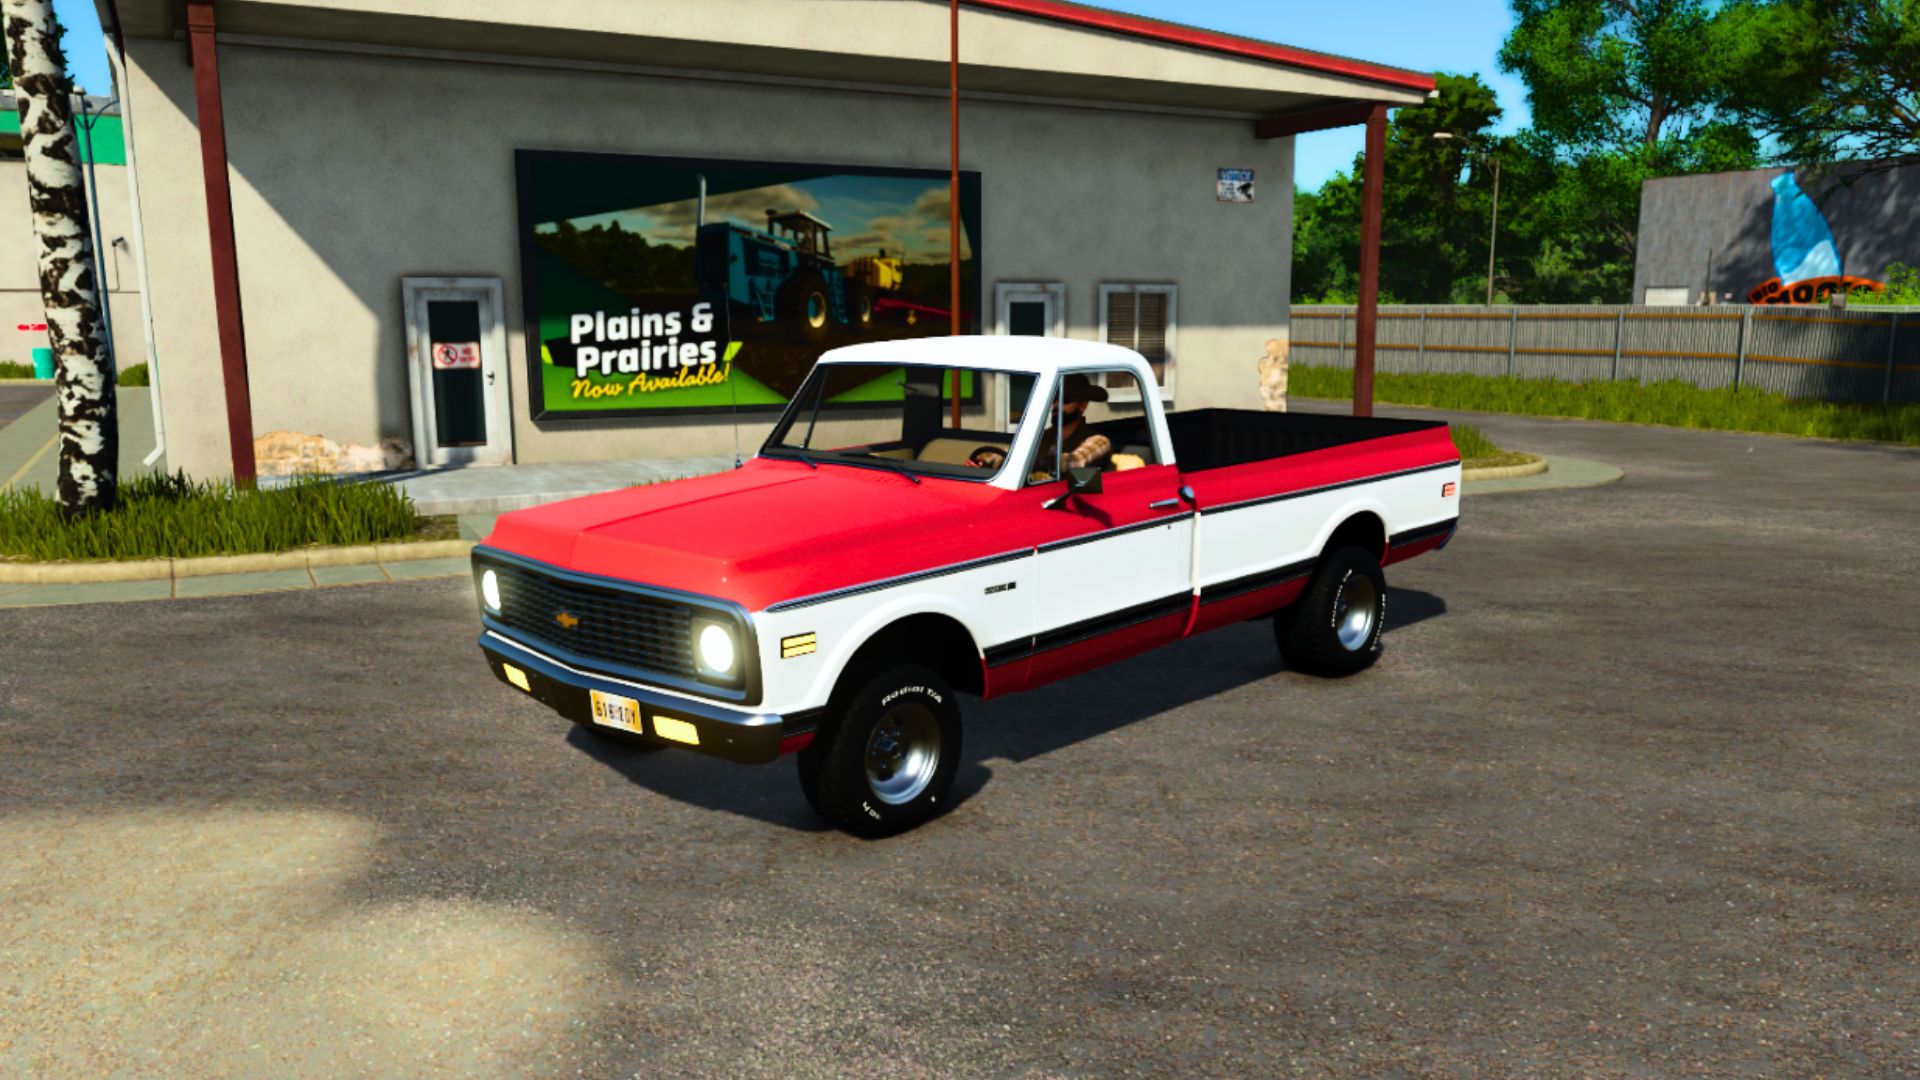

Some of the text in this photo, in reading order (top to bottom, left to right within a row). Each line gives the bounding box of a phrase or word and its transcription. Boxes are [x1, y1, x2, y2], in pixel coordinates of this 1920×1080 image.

[570, 302, 713, 344] Plains &
[576, 337, 717, 377] Prairies
[570, 362, 730, 399] Now Available!
[881, 686, 925, 706] Radial
